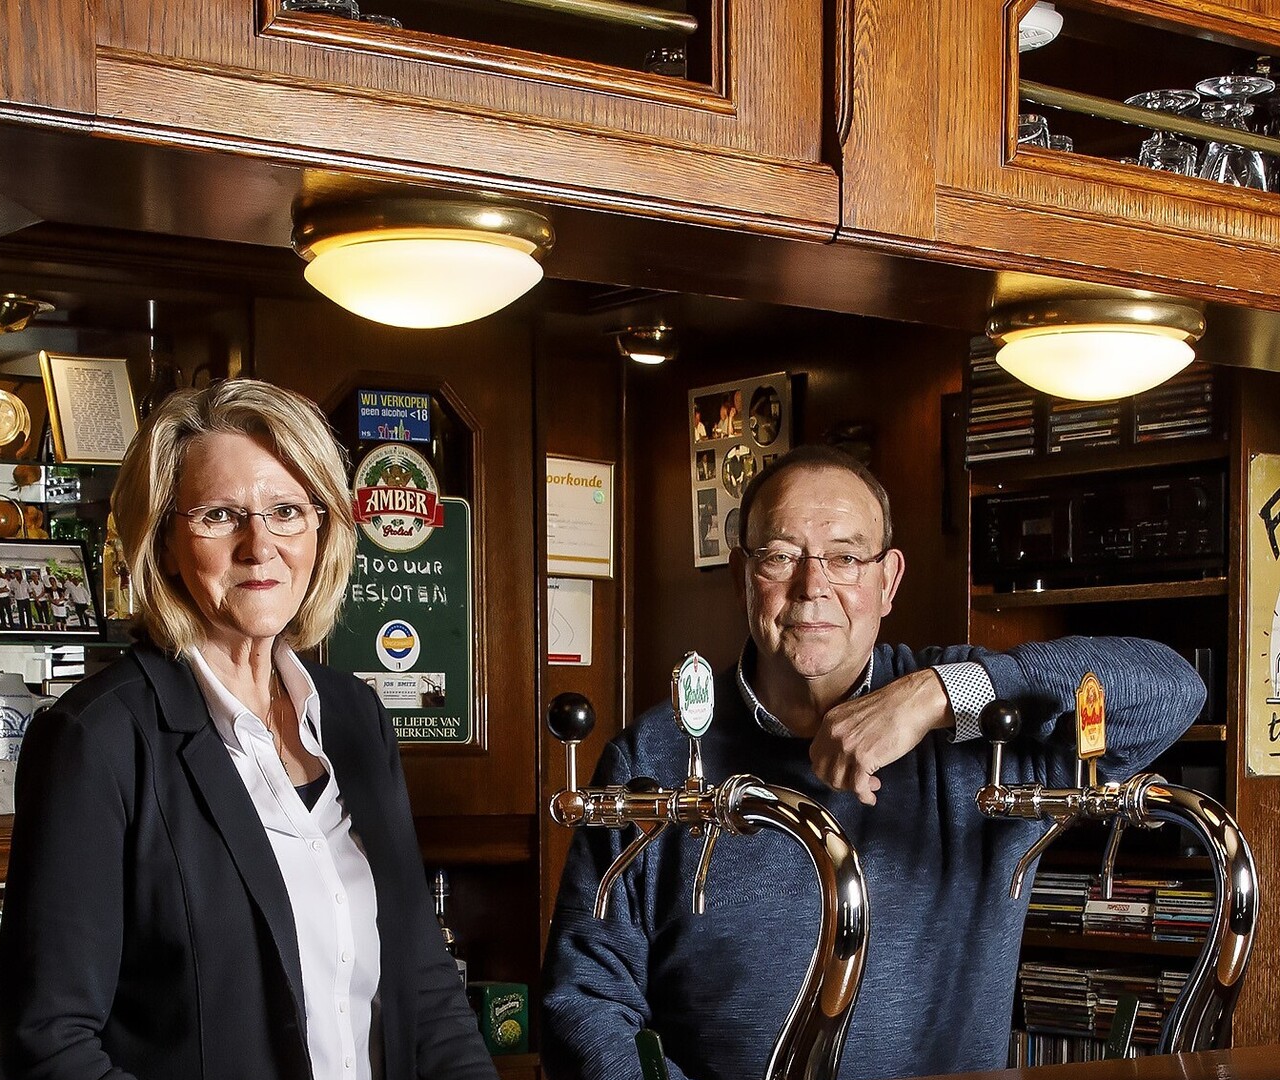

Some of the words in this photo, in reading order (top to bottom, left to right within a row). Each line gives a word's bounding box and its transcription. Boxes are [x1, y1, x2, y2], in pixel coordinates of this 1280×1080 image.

[380, 394, 428, 409] VERKOPEN
[361, 407, 380, 416] geen
[381, 408, 408, 418] alcohol
[409, 409, 428, 421] <18
[365, 489, 429, 515] AMBER
[345, 583, 448, 605] ESLOTEN
[404, 717, 438, 727] LIEFDE
[439, 717, 461, 727] VAN
